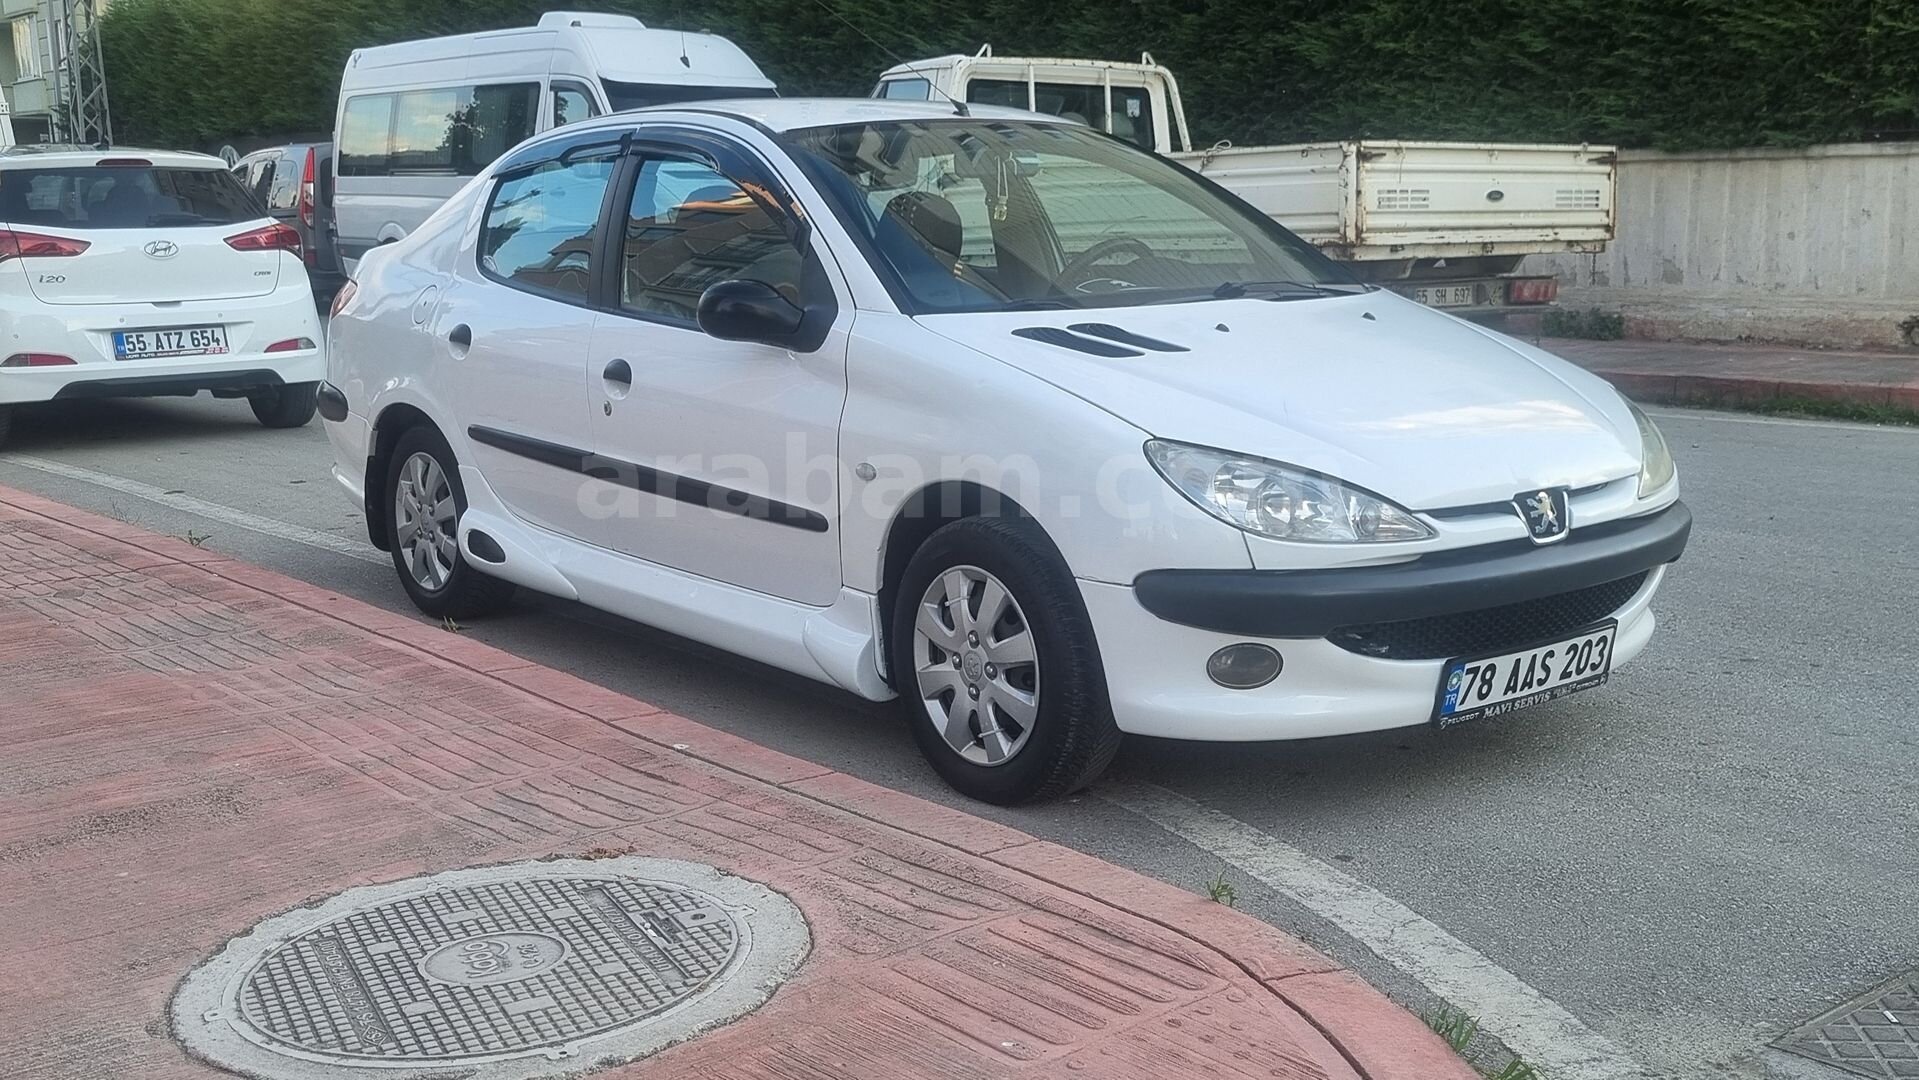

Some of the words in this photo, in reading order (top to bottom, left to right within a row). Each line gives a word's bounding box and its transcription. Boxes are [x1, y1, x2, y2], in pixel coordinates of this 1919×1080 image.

[39, 274, 66, 284] i20
[1416, 289, 1428, 305] 55
[1434, 288, 1447, 305] SH
[1454, 287, 1471, 303] 697
[125, 334, 147, 352] 55
[155, 331, 186, 350] ATZ
[190, 329, 221, 347] 654
[1458, 663, 1497, 706] 78
[1503, 650, 1555, 696] AAS
[1559, 635, 1608, 681] 203
[1445, 693, 1458, 706] TR
[1447, 712, 1480, 725] PEUGEOT
